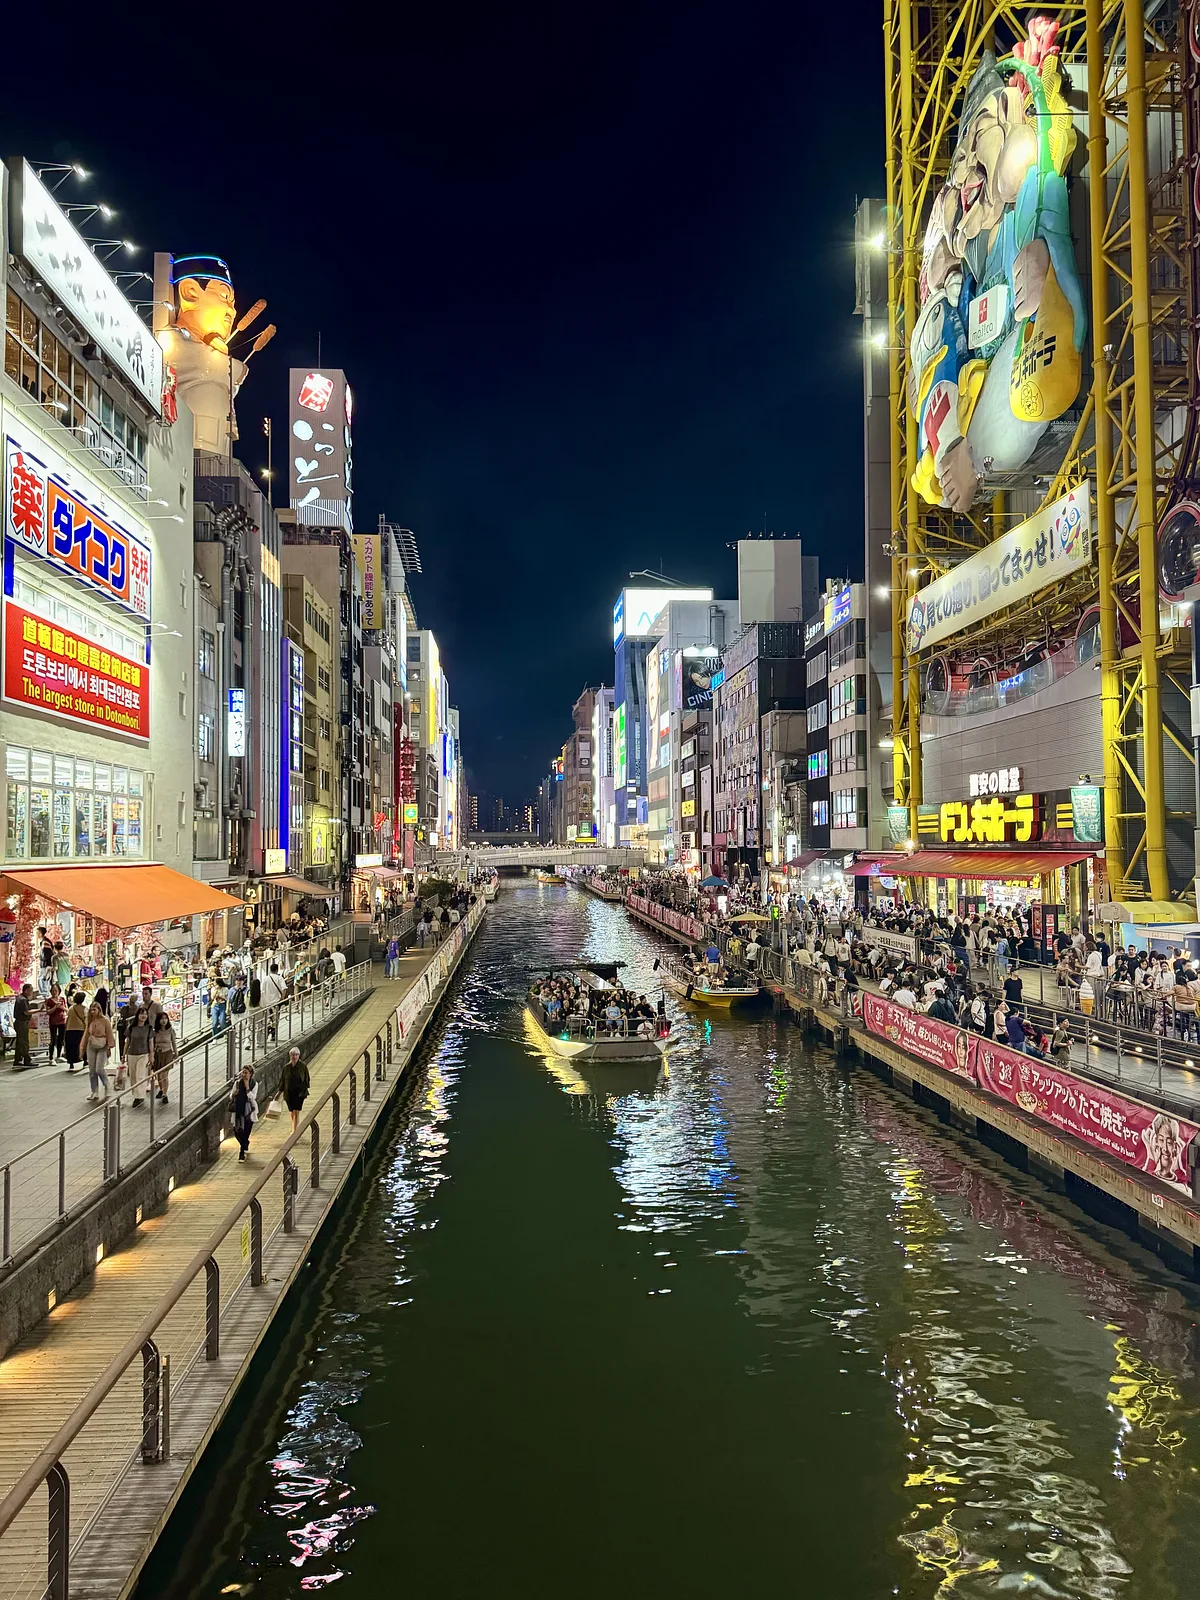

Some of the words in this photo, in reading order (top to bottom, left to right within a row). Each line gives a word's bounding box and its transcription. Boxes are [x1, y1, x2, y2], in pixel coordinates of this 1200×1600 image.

[11, 452, 44, 547] 薬
[53, 496, 126, 591] ダイコク
[131, 545, 149, 586] 免税
[133, 595, 147, 614] FREE
[135, 581, 145, 598] TAX
[22, 648, 88, 693] 도톤보리에서
[89, 674, 141, 710] 최대급인점포
[22, 677, 41, 699] The
[42, 682, 73, 710] largest
[74, 696, 95, 714] store
[96, 701, 104, 719] in
